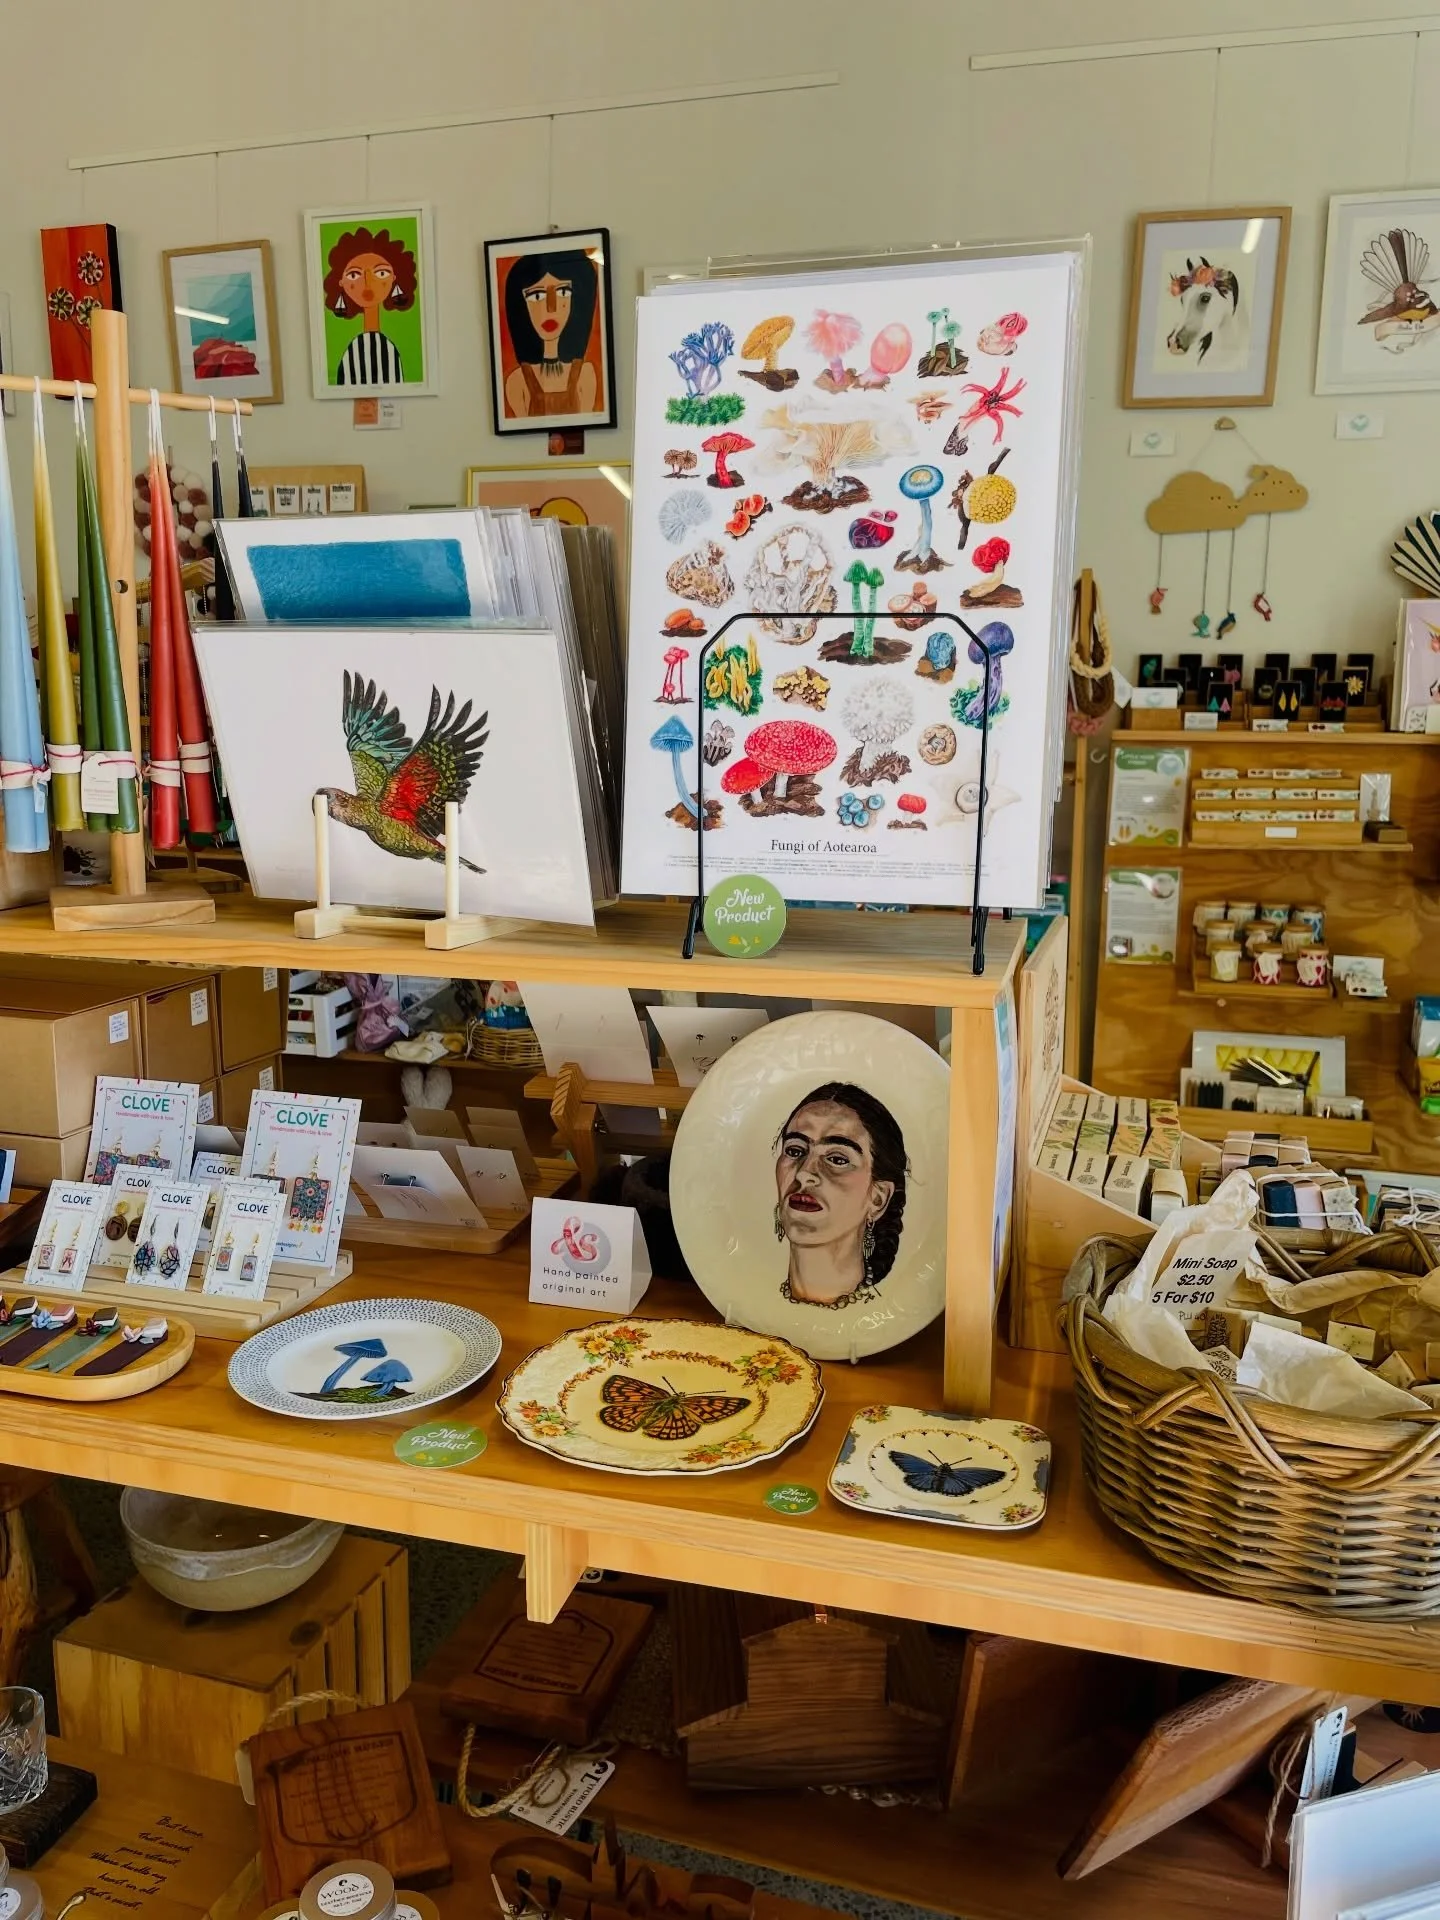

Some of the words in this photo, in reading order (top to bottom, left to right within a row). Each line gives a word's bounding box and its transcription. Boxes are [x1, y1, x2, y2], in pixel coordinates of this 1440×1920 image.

[771, 839, 804, 854] Fungi
[807, 839, 821, 851] of
[823, 841, 877, 853] Aotearoa
[726, 888, 765, 907] New
[715, 905, 776, 925] Product
[121, 1095, 170, 1112] CLOVE
[276, 1109, 329, 1127] CLOVE
[206, 1165, 236, 1176] CLOVE
[126, 1178, 150, 1188] CLOV
[62, 1194, 93, 1206] CLOVE
[161, 1193, 193, 1205] CLOVE
[237, 1202, 269, 1214] CLOVE
[1172, 1257, 1205, 1269] Mini
[1204, 1257, 1238, 1270] Soap
[543, 1267, 571, 1277] Hand
[575, 1272, 618, 1283] painted
[1177, 1274, 1214, 1286] $2.50
[542, 1283, 585, 1294] original
[590, 1288, 606, 1297] art
[1151, 1291, 1163, 1303] 5
[1163, 1291, 1188, 1303] For
[1189, 1291, 1214, 1304] $10
[428, 1428, 470, 1440] New
[410, 1435, 476, 1450] Product
[772, 1491, 812, 1503] Product
[781, 1488, 808, 1497] New
